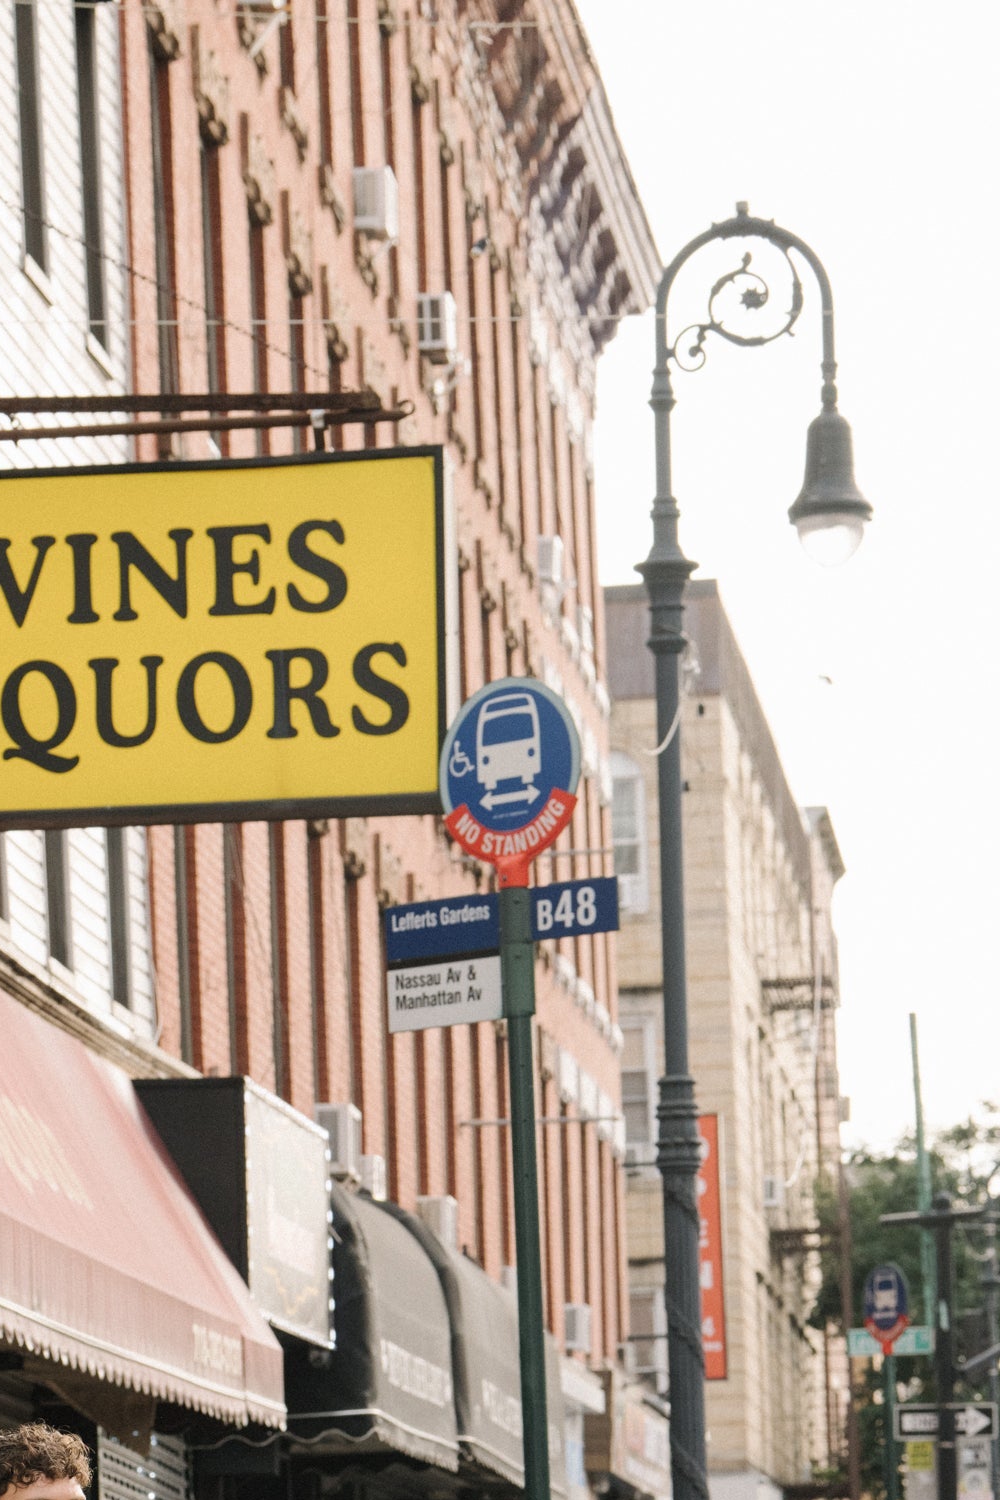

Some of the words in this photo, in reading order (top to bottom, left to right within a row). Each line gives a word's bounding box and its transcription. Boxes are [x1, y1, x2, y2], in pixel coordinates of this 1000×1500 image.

[455, 812, 479, 844] NO
[481, 798, 566, 857] STANDING
[391, 910, 438, 932] Lefferts
[440, 904, 490, 926] Gardens
[536, 887, 597, 931] B48
[395, 972, 441, 991] Nassau
[446, 967, 461, 984] Av
[467, 964, 476, 981] &
[396, 991, 461, 1011] Manhattan
[467, 986, 482, 1002] Av
